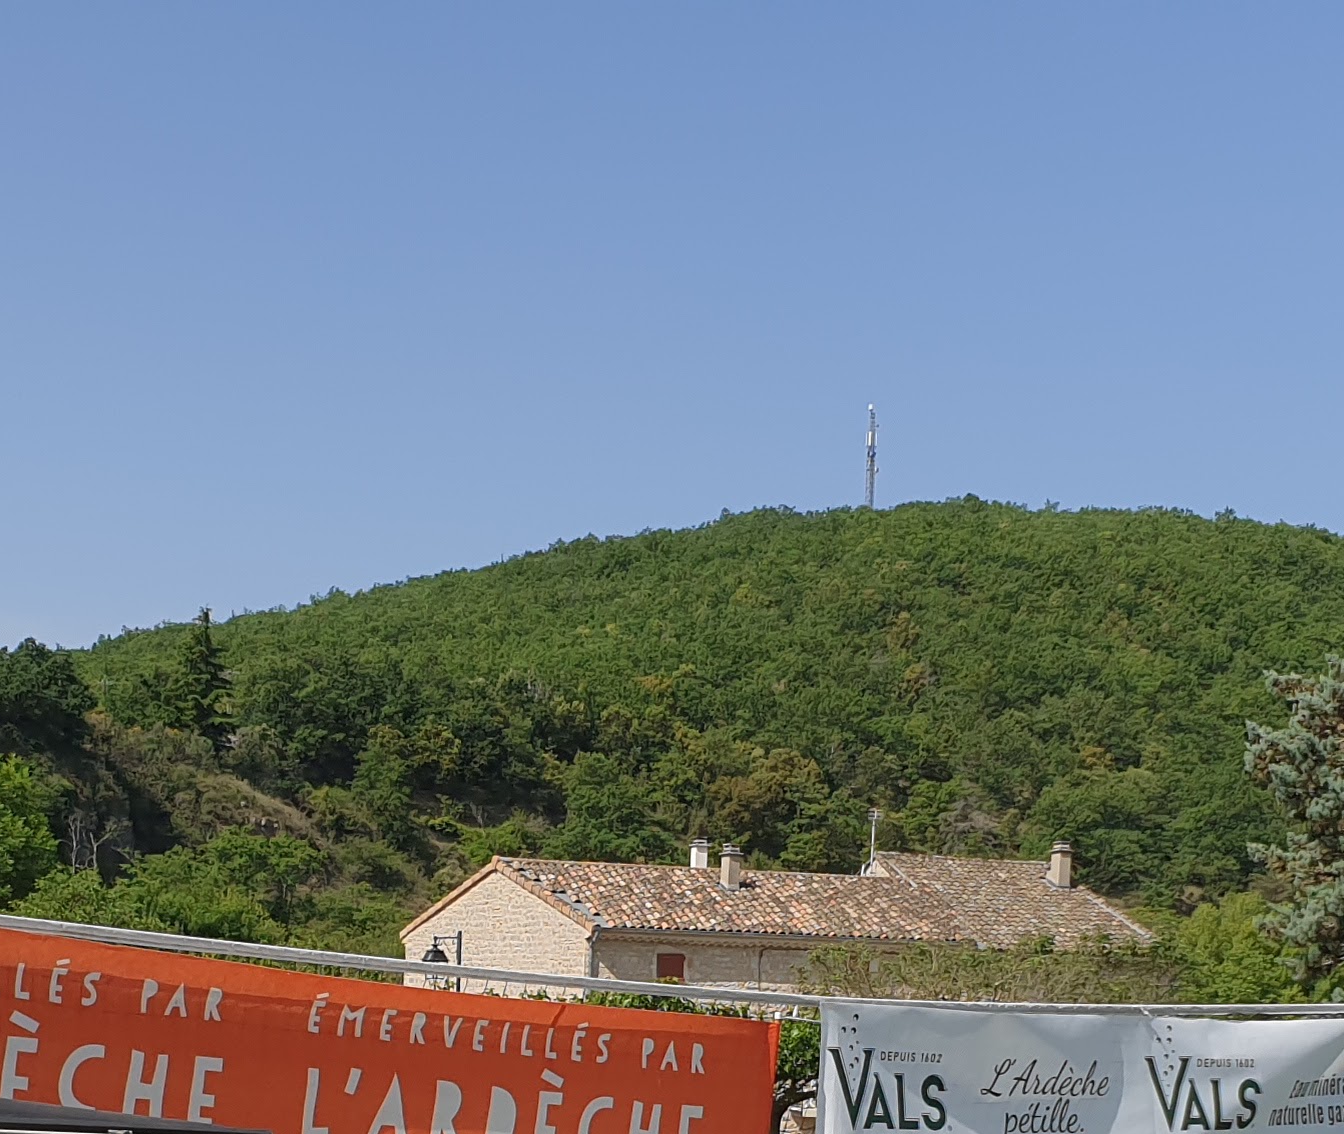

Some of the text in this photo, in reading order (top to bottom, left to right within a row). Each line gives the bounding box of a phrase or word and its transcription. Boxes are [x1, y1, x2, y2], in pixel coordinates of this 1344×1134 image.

[140, 977, 223, 1022] PAR
[306, 992, 706, 1075] ÉMERVEILLÉS PAR
[880, 1050, 944, 1064] DEPUIS 1602
[1196, 1058, 1255, 1068] DEPUIS 1602
[827, 1046, 948, 1131] VALS
[979, 1058, 1110, 1097] L'Ardèche
[1144, 1055, 1263, 1133] VALS
[1288, 1080, 1311, 1099] Eau
[1268, 1103, 1325, 1127] naturelle
